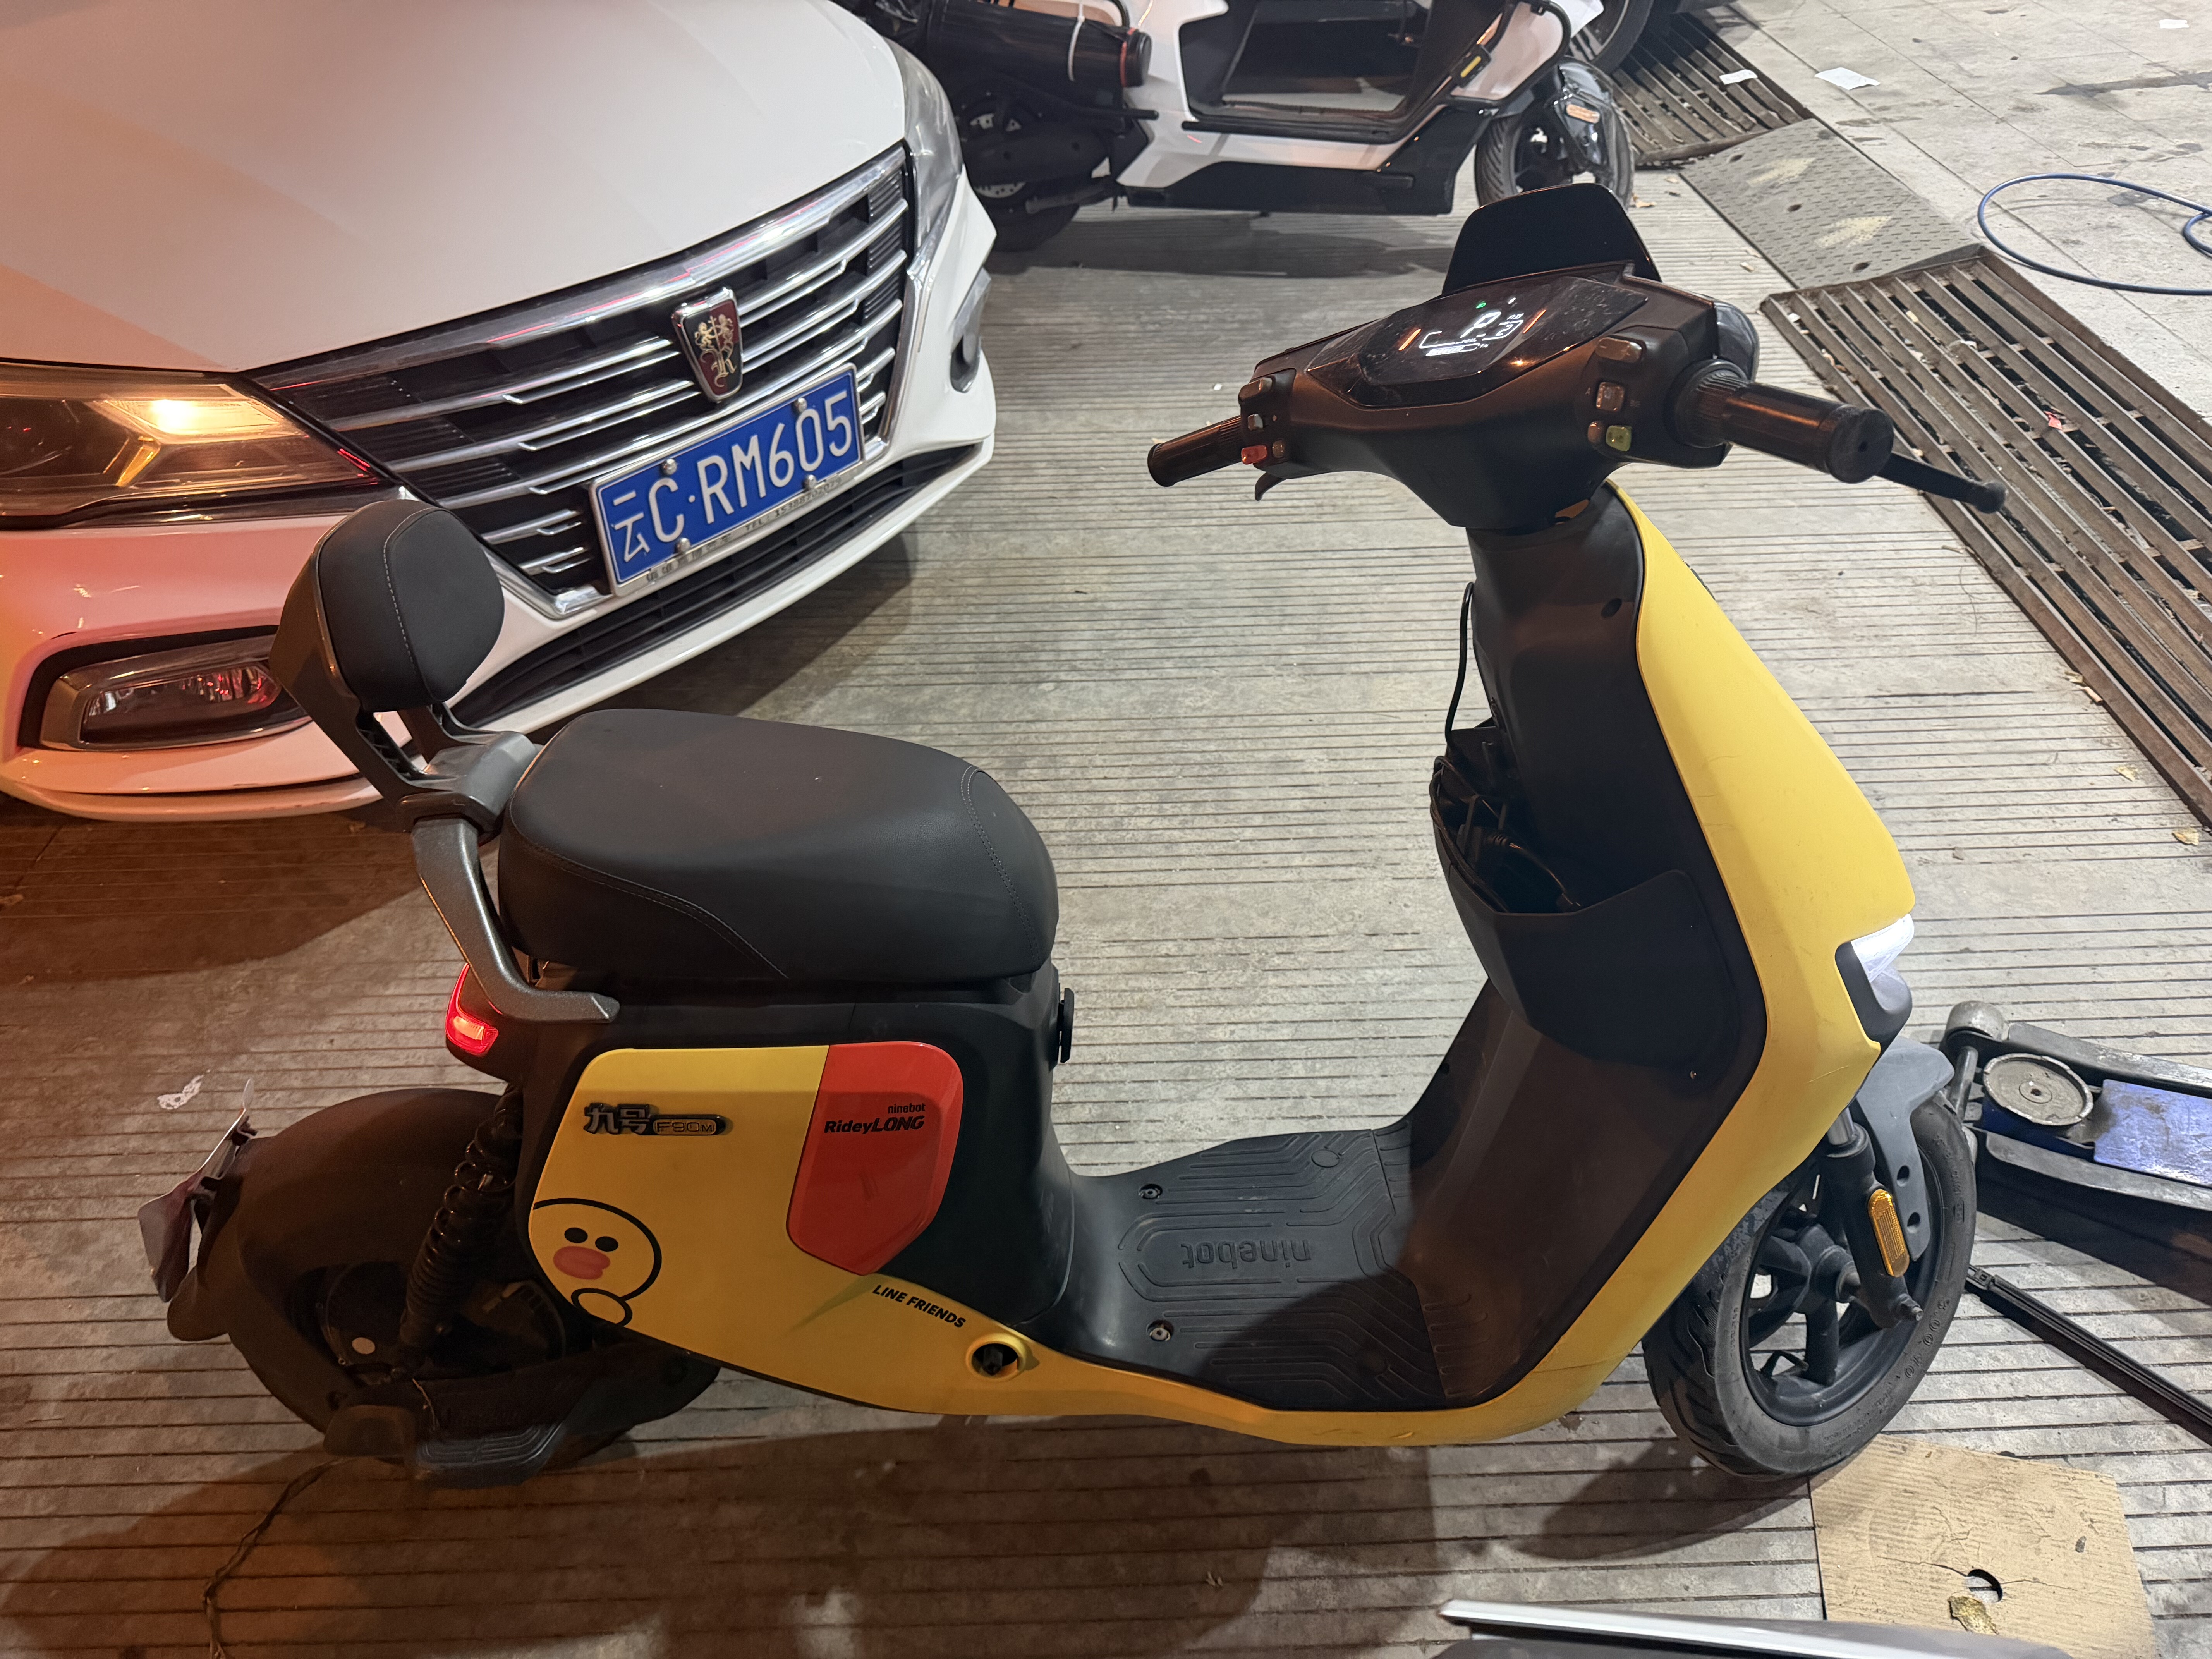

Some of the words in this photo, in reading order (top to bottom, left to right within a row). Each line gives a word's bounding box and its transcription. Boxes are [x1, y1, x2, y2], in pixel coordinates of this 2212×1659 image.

[584, 1103, 651, 1135] 九号
[657, 1121, 715, 1133] F90M
[888, 1103, 926, 1114] ninebot
[824, 1115, 925, 1134] RideyLONG
[1180, 1240, 1312, 1269] ninebot
[872, 1285, 908, 1302] LINE
[906, 1296, 966, 1327] FRIENDS
